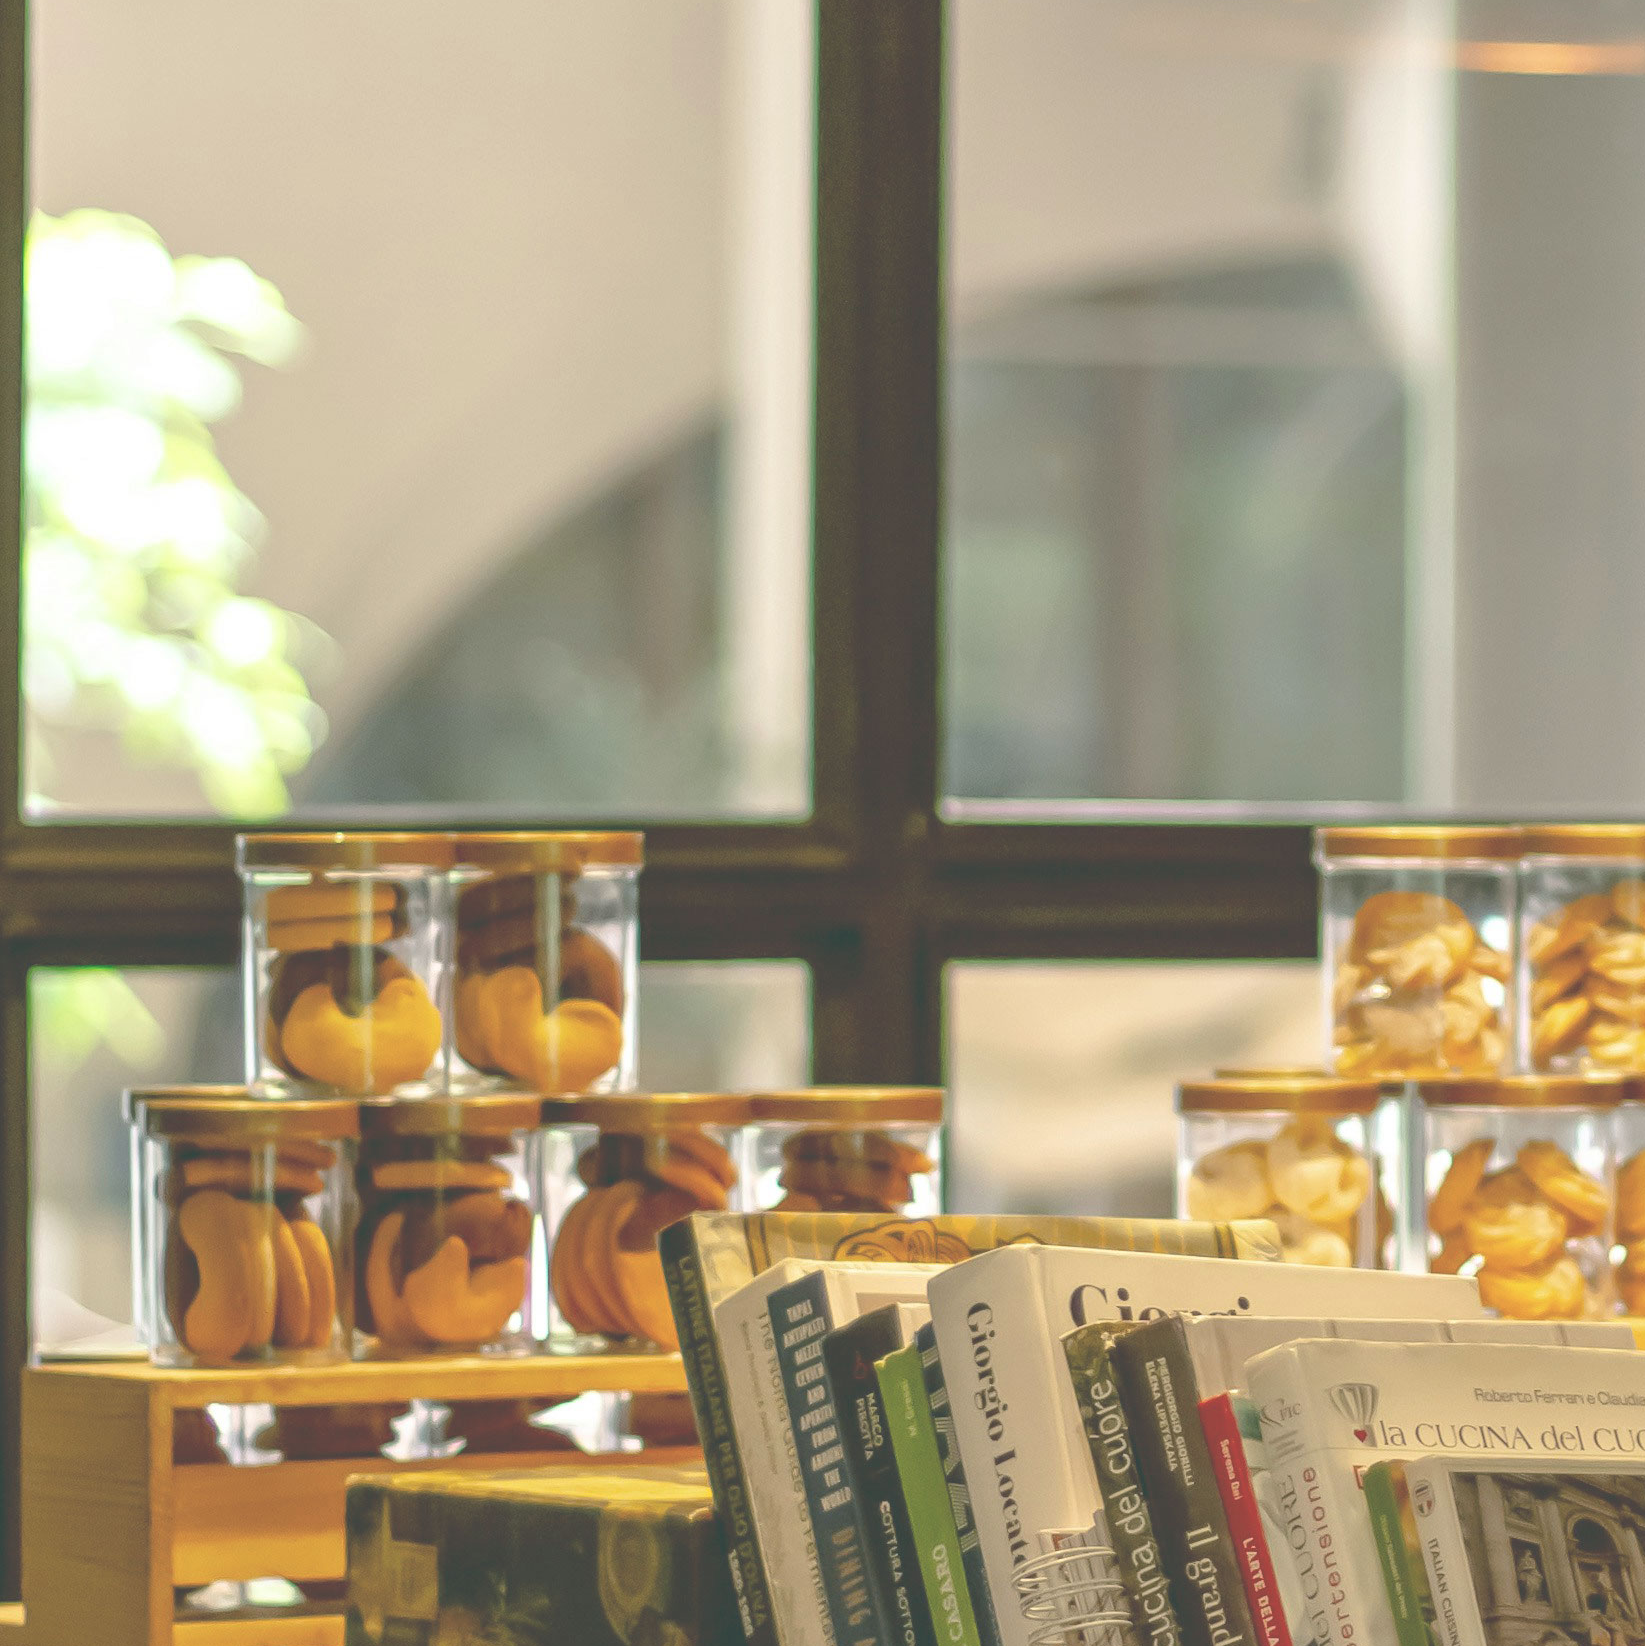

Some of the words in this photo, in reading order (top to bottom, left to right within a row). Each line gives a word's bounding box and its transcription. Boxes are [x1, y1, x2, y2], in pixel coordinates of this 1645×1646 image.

[807, 1384, 826, 1405] AND
[967, 1302, 1009, 1442] Giorgio
[1145, 1360, 1161, 1401] ELENA
[1473, 1387, 1533, 1404] Roberto
[1587, 1395, 1596, 1406] e
[812, 1425, 838, 1449] FROM
[856, 1397, 874, 1461] PIROTTA
[865, 1391, 884, 1448] MARCO
[1157, 1356, 1184, 1435] PIERGIORGIO
[1174, 1436, 1195, 1487] GIORILLI
[1379, 1420, 1407, 1447] la
[1415, 1422, 1533, 1450] CUCINA
[1541, 1425, 1585, 1451] del
[823, 1467, 841, 1488] THE
[1219, 1438, 1236, 1481] Serena
[820, 1486, 851, 1513] WORLD
[1107, 1483, 1148, 1536] del
[880, 1500, 903, 1583] COTTURA
[1185, 1522, 1220, 1551] Il
[1277, 1474, 1320, 1601] CUORE
[832, 1526, 871, 1626] DINING
[1242, 1537, 1266, 1593] L'ARTE
[1427, 1537, 1450, 1594] ITALIAN
[931, 1543, 964, 1642] CASARO
